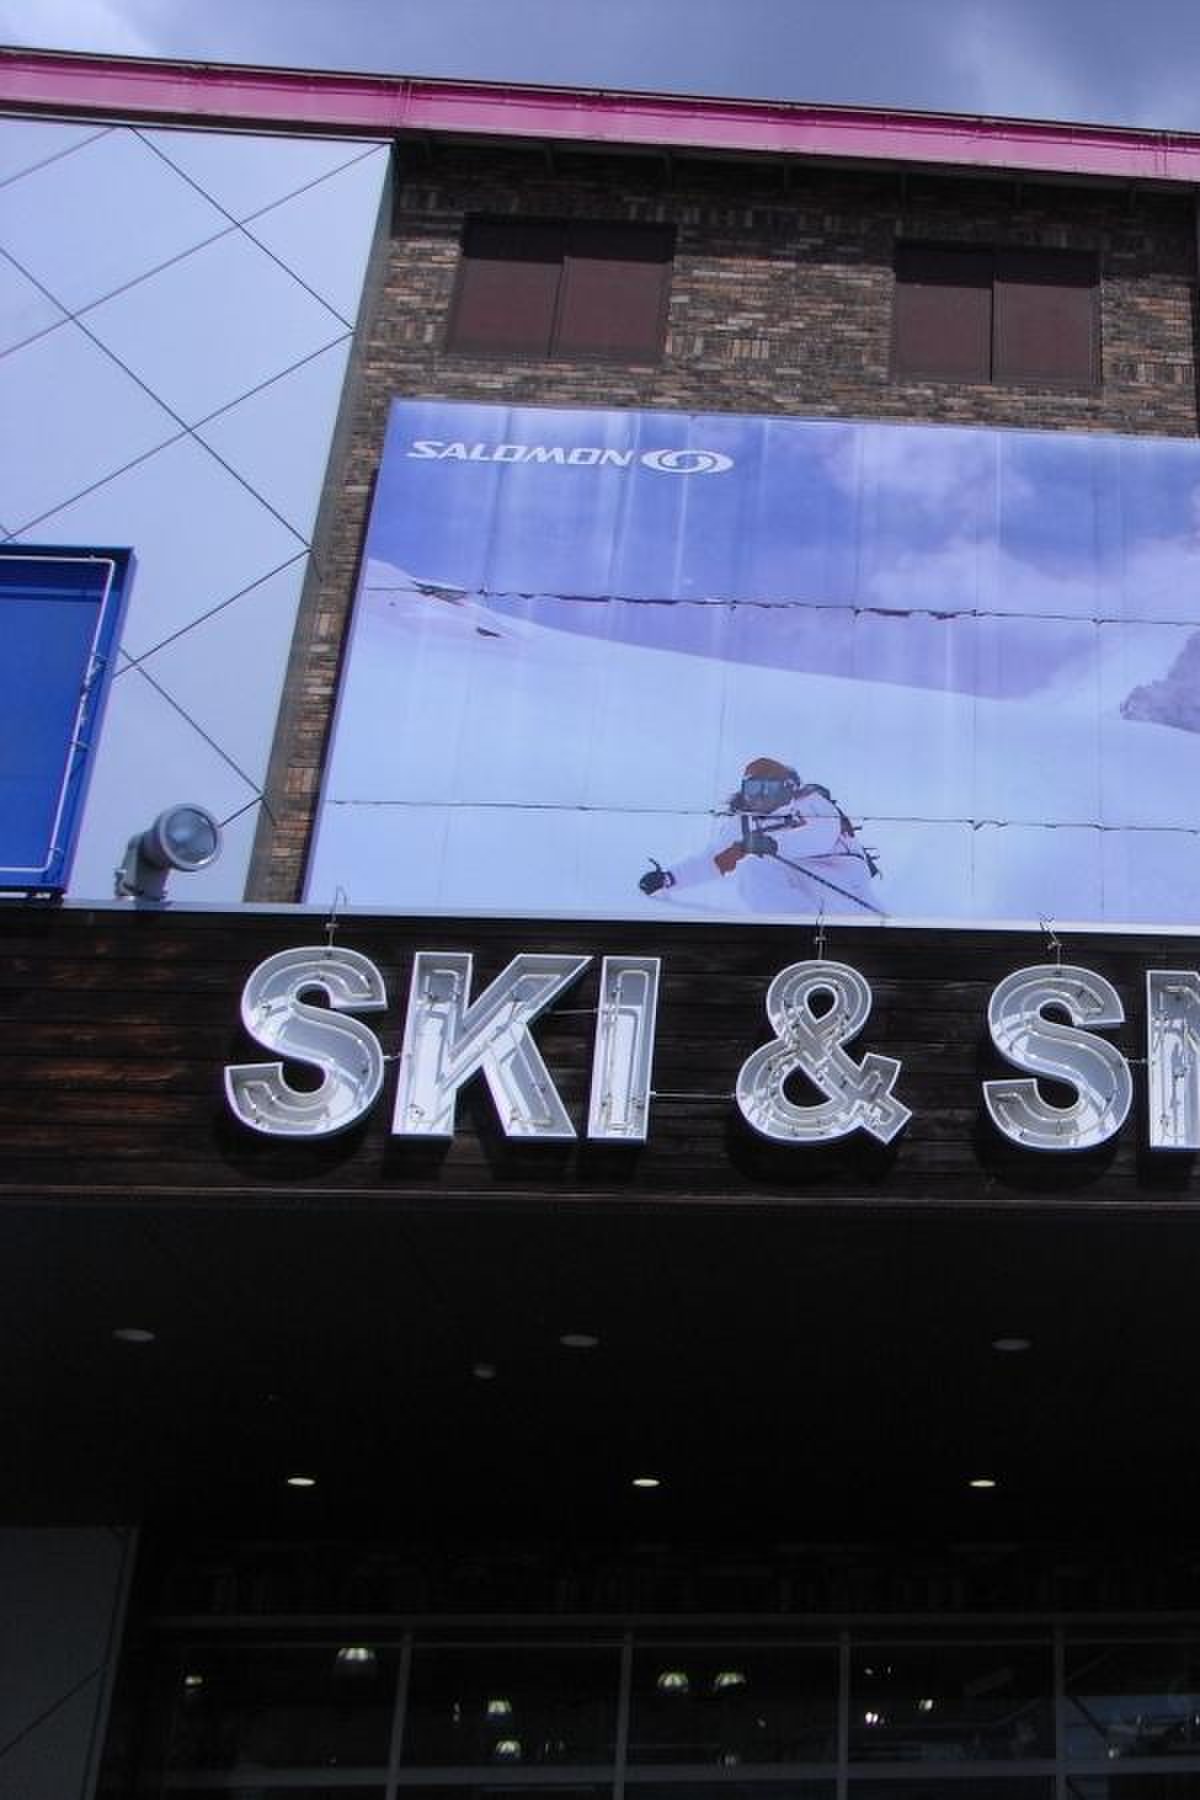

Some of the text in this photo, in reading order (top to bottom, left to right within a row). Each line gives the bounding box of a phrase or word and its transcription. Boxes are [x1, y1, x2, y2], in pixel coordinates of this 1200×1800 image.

[406, 440, 633, 466] SALOMON
[224, 946, 661, 1140] SKI
[736, 959, 912, 1144] &
